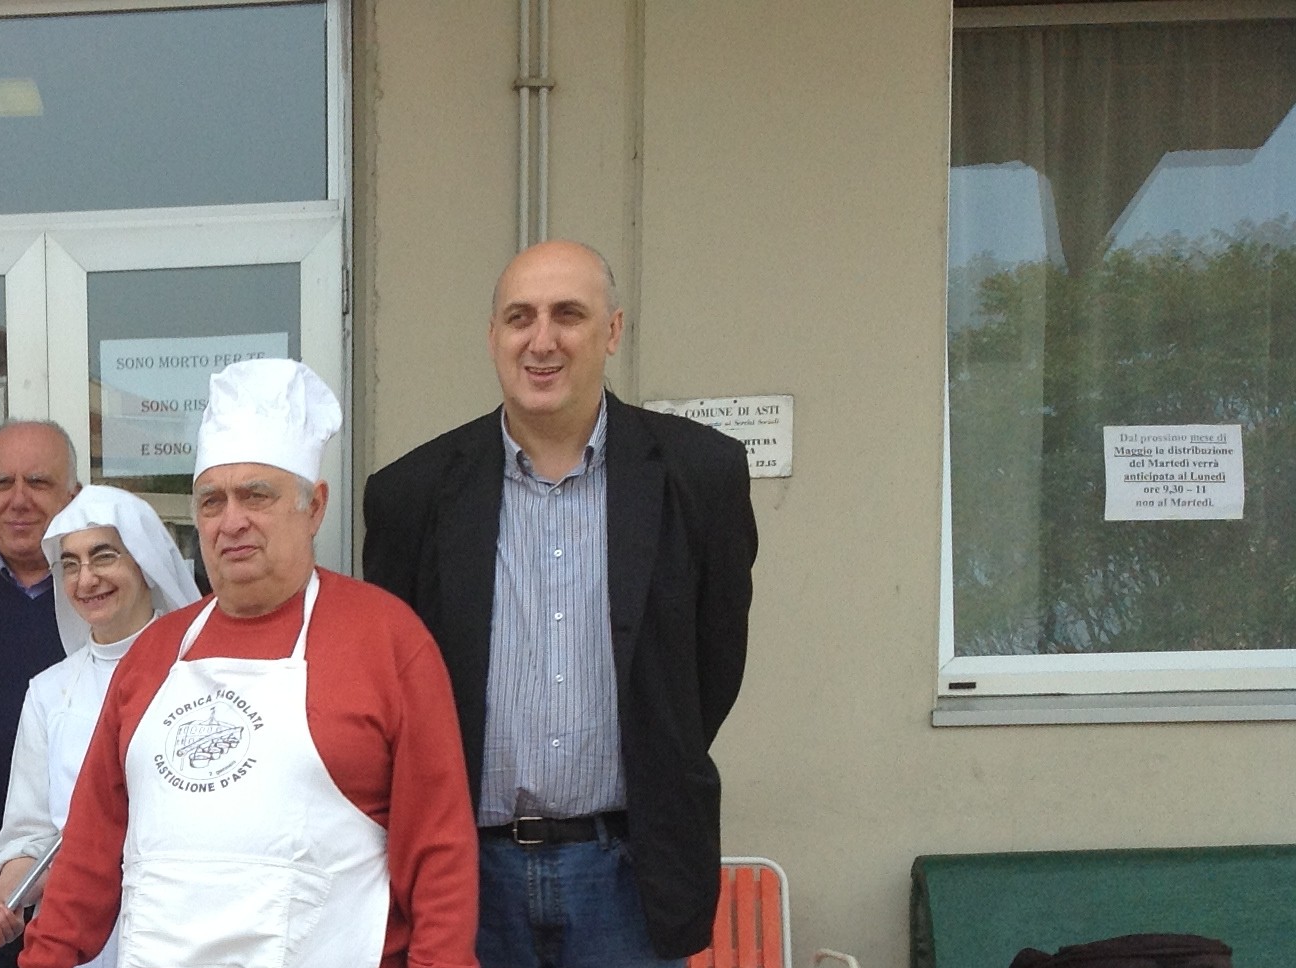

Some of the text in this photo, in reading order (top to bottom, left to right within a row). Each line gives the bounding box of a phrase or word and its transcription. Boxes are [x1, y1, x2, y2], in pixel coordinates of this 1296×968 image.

[116, 356, 155, 371] SONO
[159, 354, 209, 369] MORTO
[214, 353, 242, 367] PER
[141, 400, 179, 413] SONO
[685, 405, 780, 419] COMUNE DI ASTI
[1120, 433, 1227, 444] Dal prossimo mese di
[141, 443, 192, 456] E SONO
[1114, 445, 1234, 457] Maggio la distribuzione
[1129, 459, 1220, 468] del Martedì verrà
[1124, 471, 1226, 482] anticipata al Lunedì
[1196, 485, 1207, 494] 11
[1135, 500, 1155, 508] non
[1157, 499, 1167, 507] al
[163, 689, 264, 731] STORICA FAGIOLATA
[154, 754, 216, 793] CASTIGLIONE
[220, 757, 257, 788] D'ASTI
